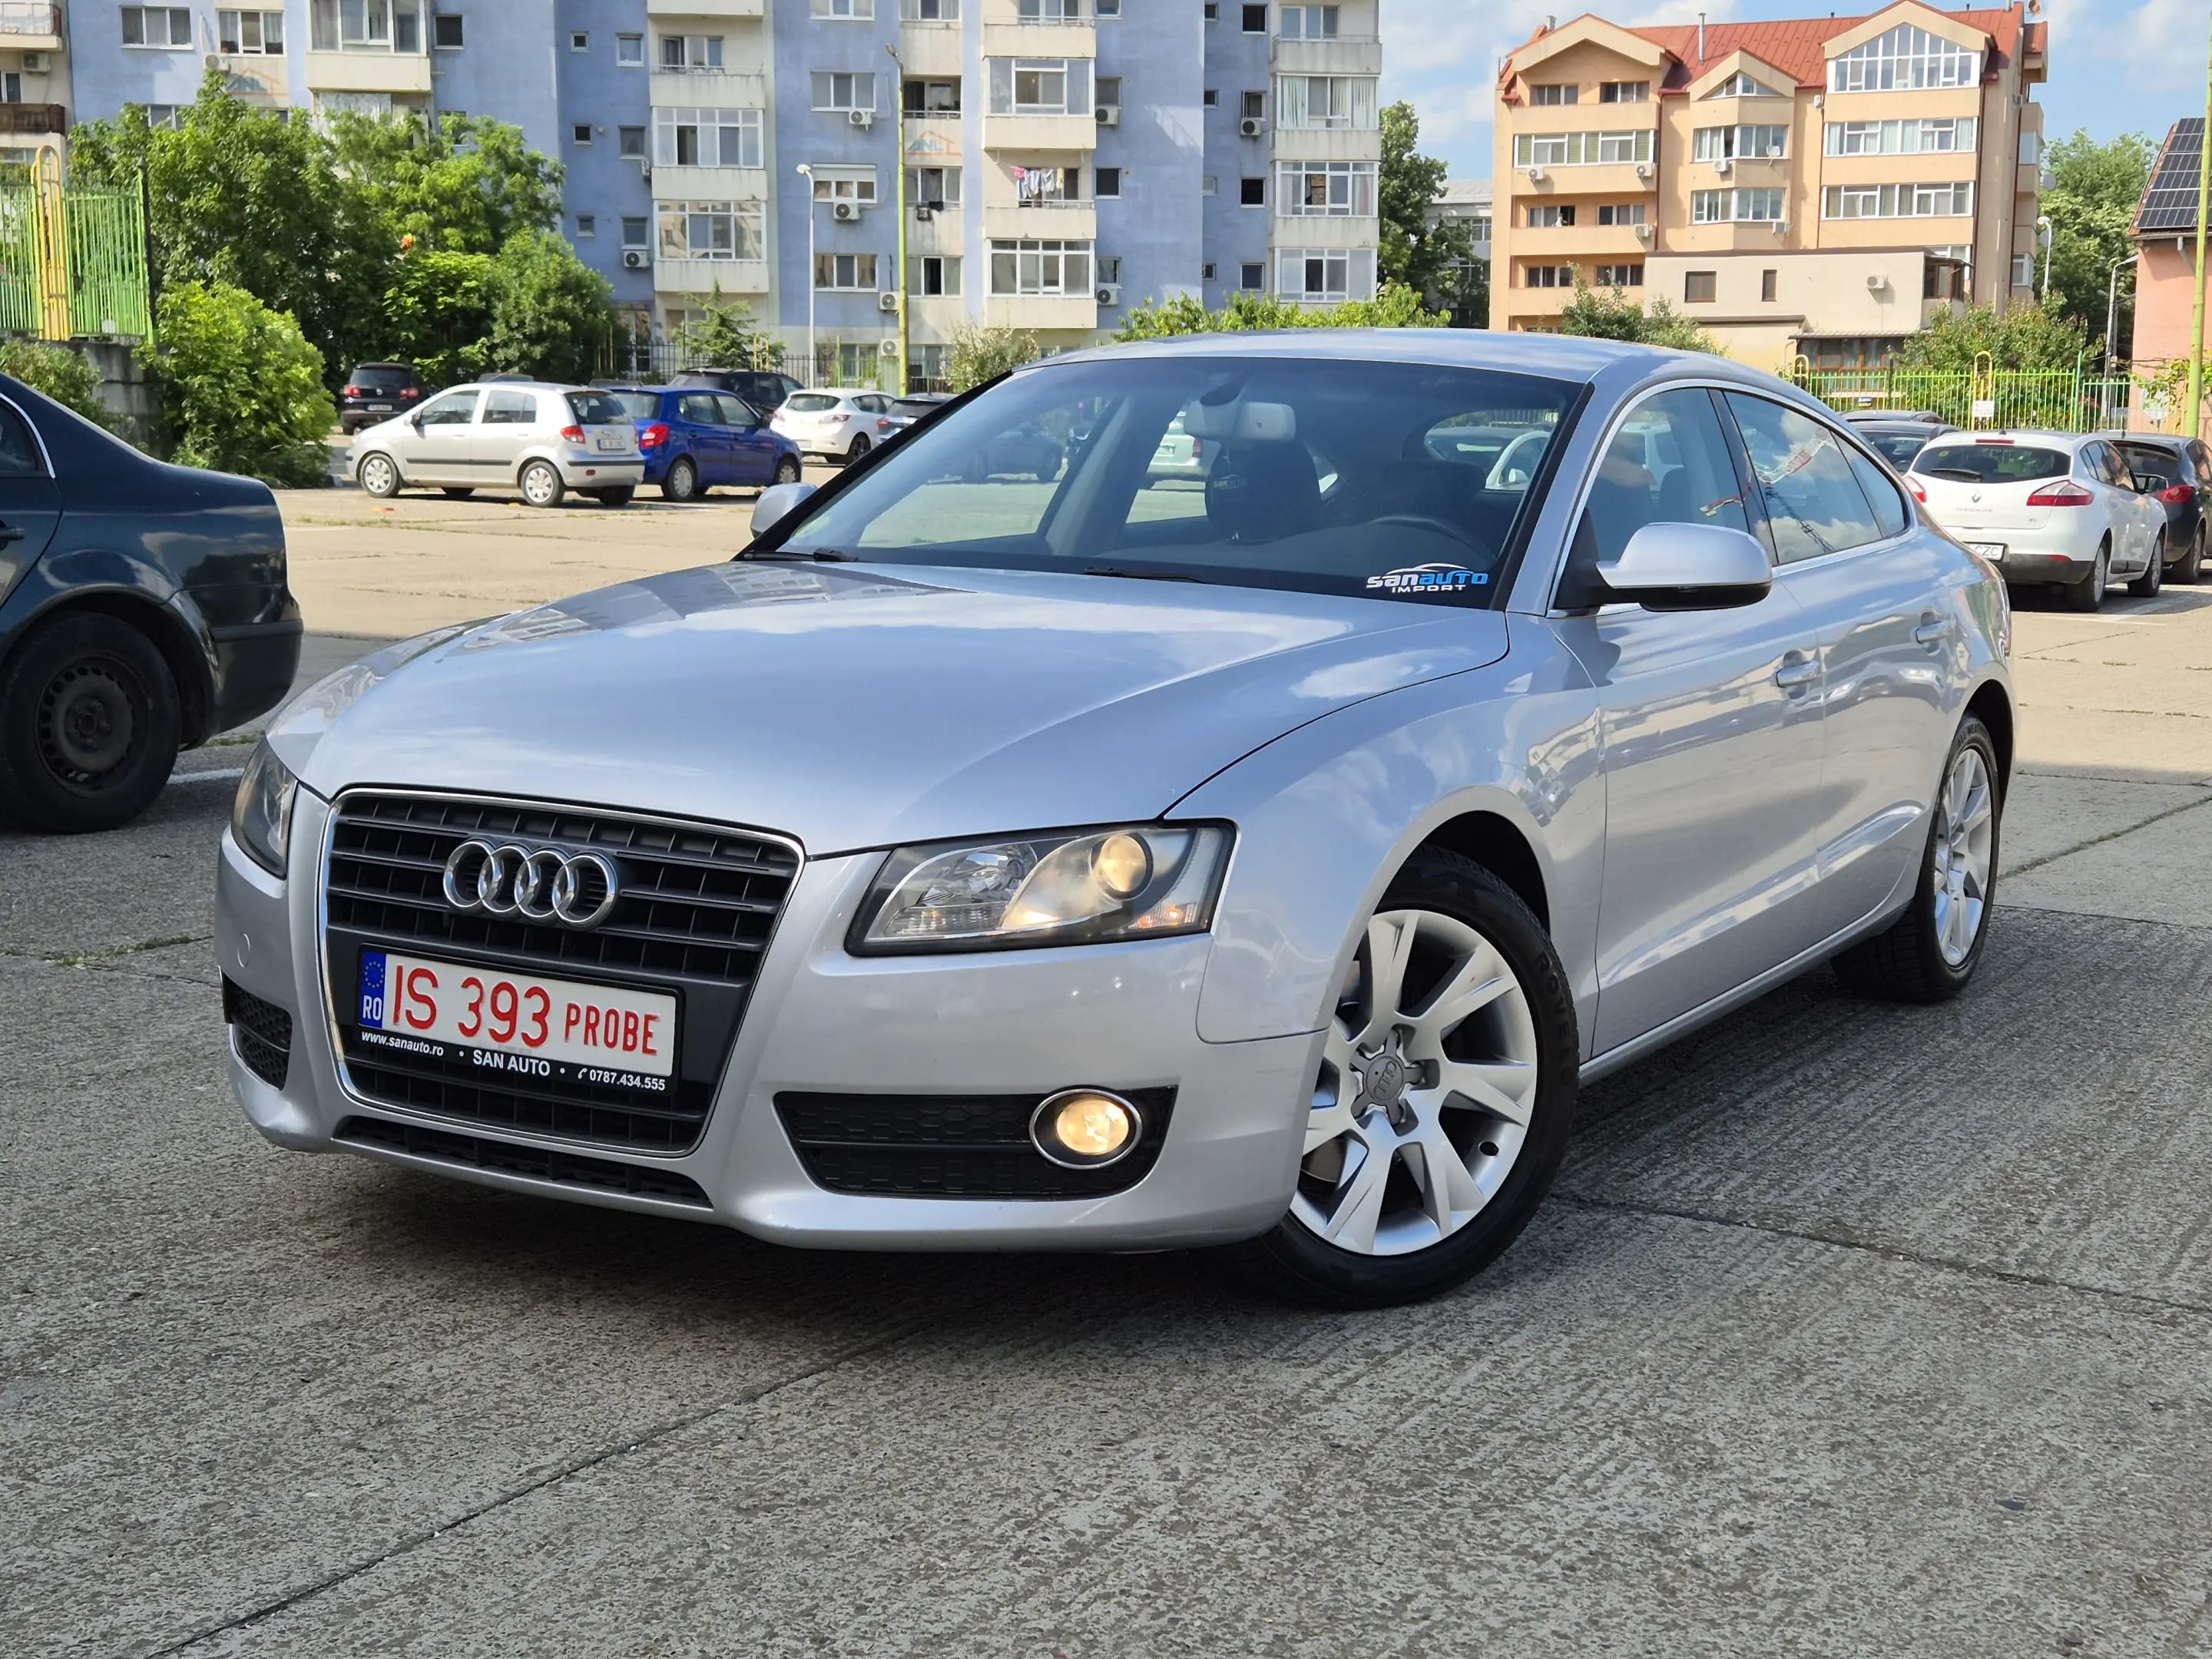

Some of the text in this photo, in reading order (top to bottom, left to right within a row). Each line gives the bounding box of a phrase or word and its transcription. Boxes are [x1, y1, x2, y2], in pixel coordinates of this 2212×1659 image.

[1392, 584, 1466, 594] IMPORT
[363, 995, 382, 1021] RO
[392, 965, 660, 1056] IS 393 PROBE
[361, 1031, 445, 1056] www.sanauto.ro
[472, 1049, 551, 1076] SAN AUTO
[589, 1069, 666, 1091] 0787.434.555
